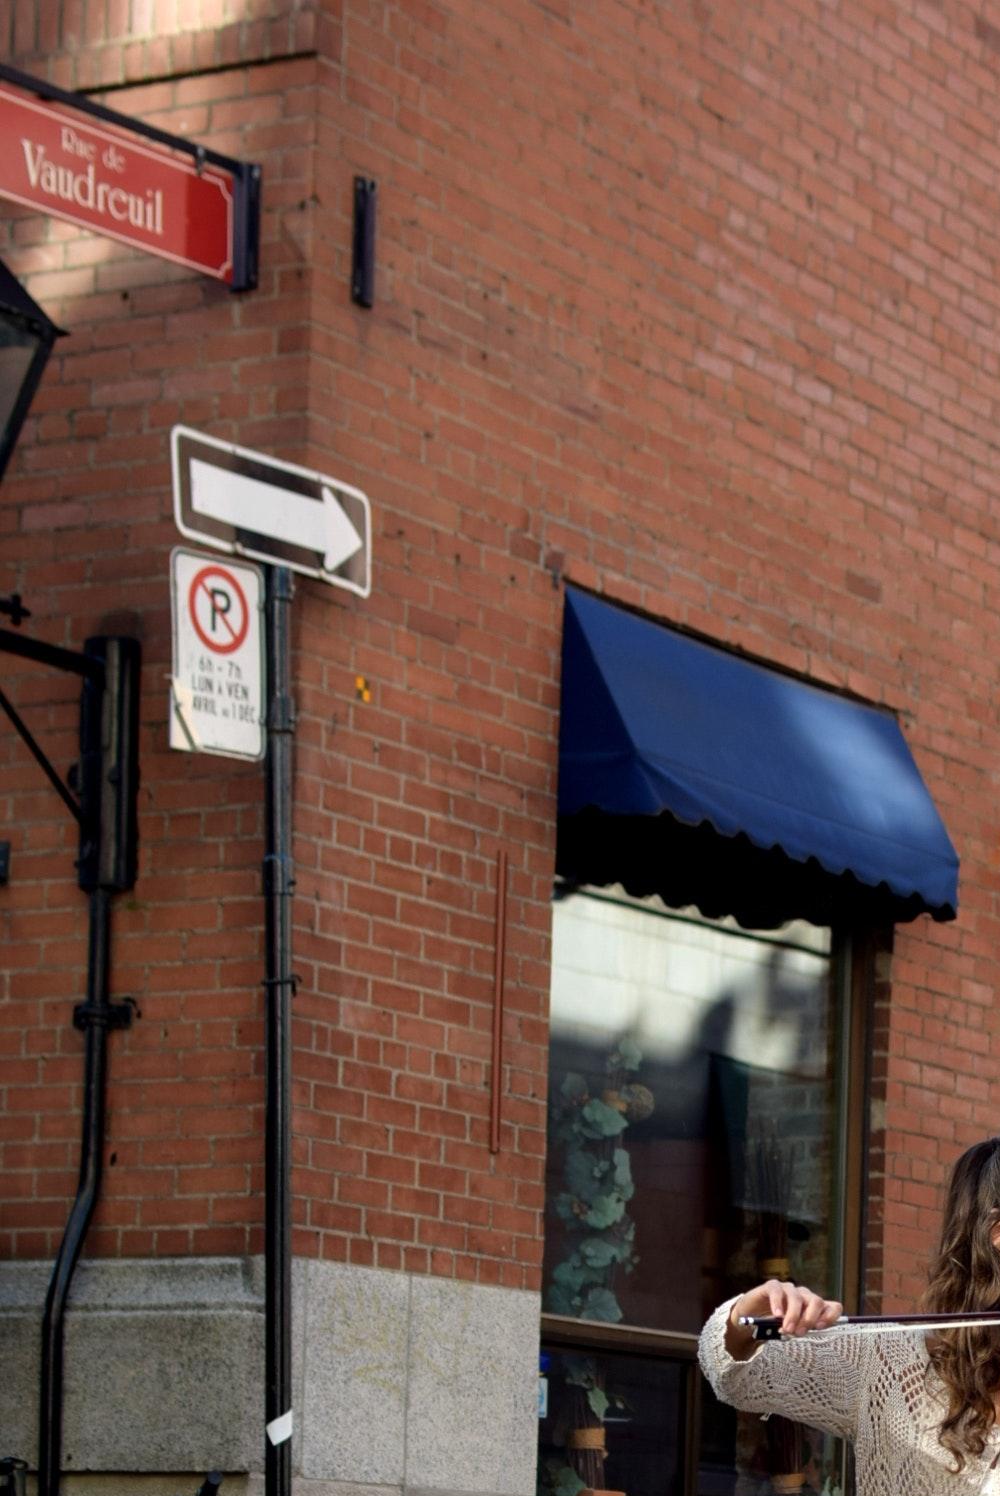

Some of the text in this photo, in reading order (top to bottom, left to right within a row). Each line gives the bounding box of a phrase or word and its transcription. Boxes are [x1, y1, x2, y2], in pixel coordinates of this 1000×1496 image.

[62, 127, 126, 173] Rue de
[21, 138, 164, 234] Vaudreuil
[211, 588, 231, 631] P
[226, 680, 249, 701] VEN
